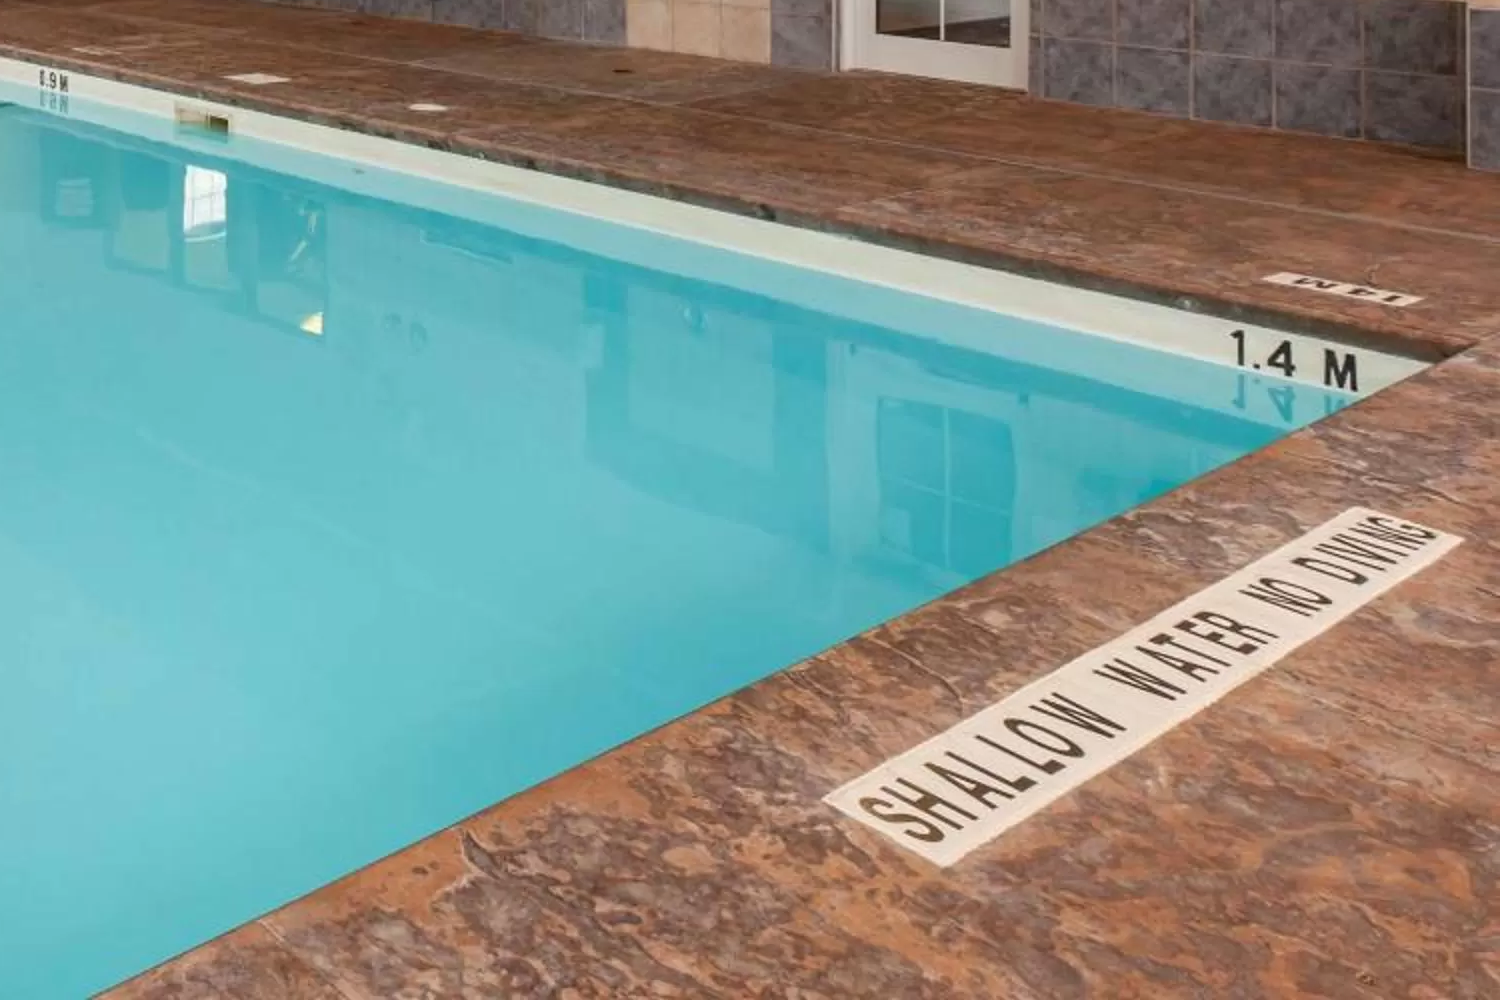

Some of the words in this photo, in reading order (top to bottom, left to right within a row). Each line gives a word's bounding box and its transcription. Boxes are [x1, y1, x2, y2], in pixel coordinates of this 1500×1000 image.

[59, 73, 69, 93] M
[1229, 329, 1296, 377] 1.4
[1323, 348, 1358, 393] M
[858, 692, 1128, 844] SHALLOW
[1092, 610, 1279, 701] WATER
[1238, 577, 1333, 618] NO
[1293, 516, 1438, 586] DIVING
